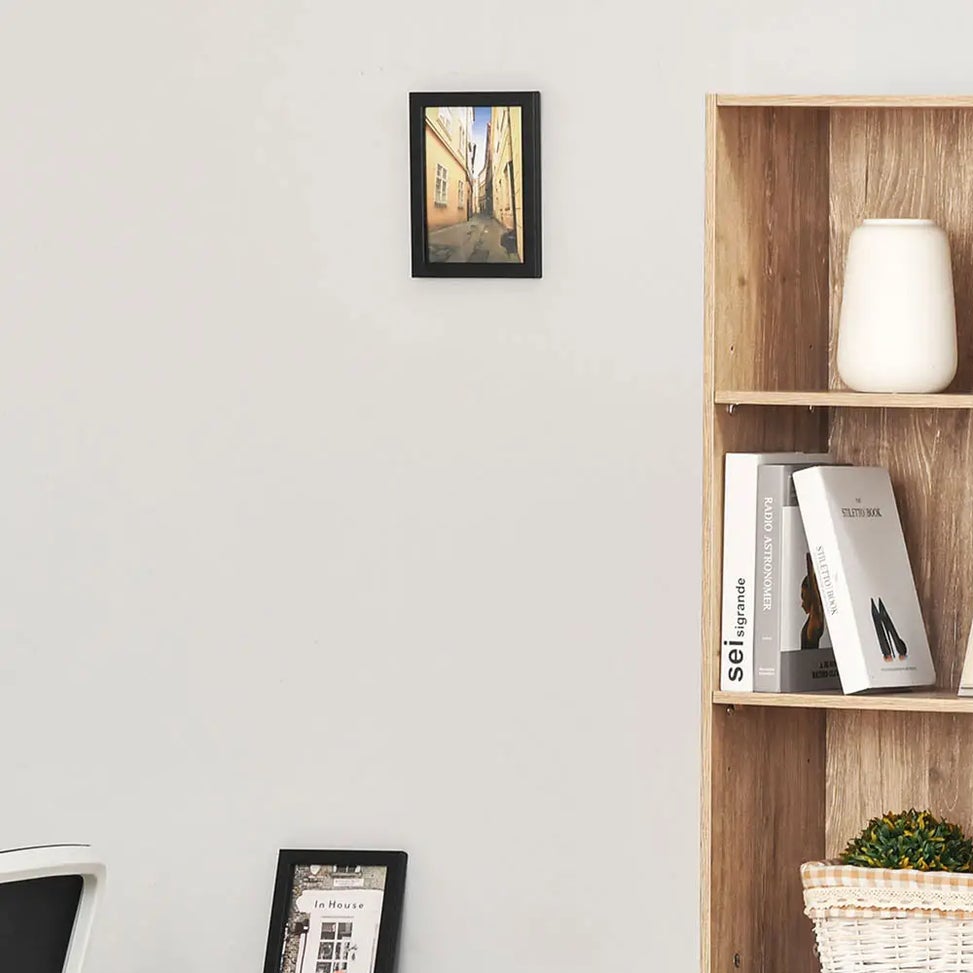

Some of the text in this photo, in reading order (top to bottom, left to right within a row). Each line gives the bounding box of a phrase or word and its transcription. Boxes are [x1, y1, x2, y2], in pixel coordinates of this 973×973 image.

[762, 497, 774, 612] RADIO ASTRONOMER
[723, 577, 748, 682] sei sigrande
[314, 900, 364, 909] In House
